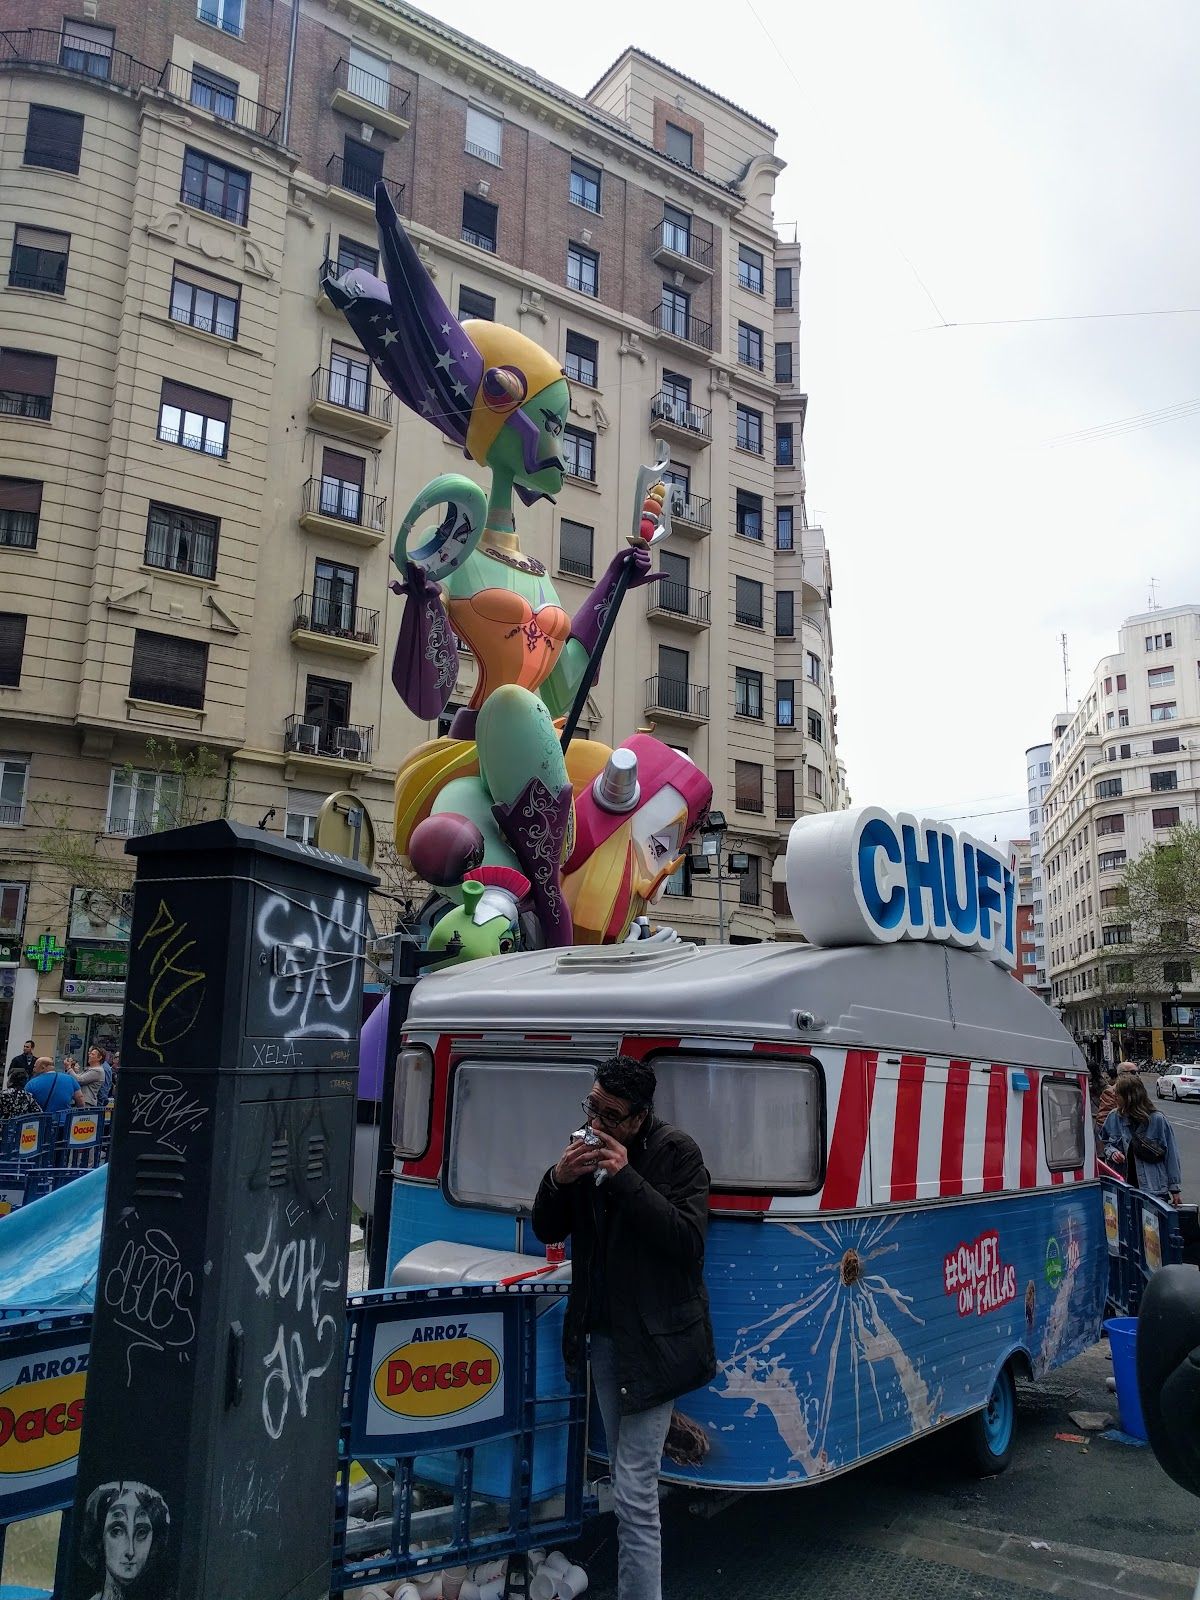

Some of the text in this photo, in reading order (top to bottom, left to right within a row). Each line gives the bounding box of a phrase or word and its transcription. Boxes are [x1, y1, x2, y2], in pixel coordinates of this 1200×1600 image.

[73, 1125, 95, 1136] Dacsa
[945, 1236, 1000, 1291] #CHUFI
[959, 1265, 1016, 1315] ON FALLAS
[411, 1322, 469, 1344] ARROZ
[15, 1353, 90, 1386] ARROZ
[386, 1359, 493, 1397] Dacsa
